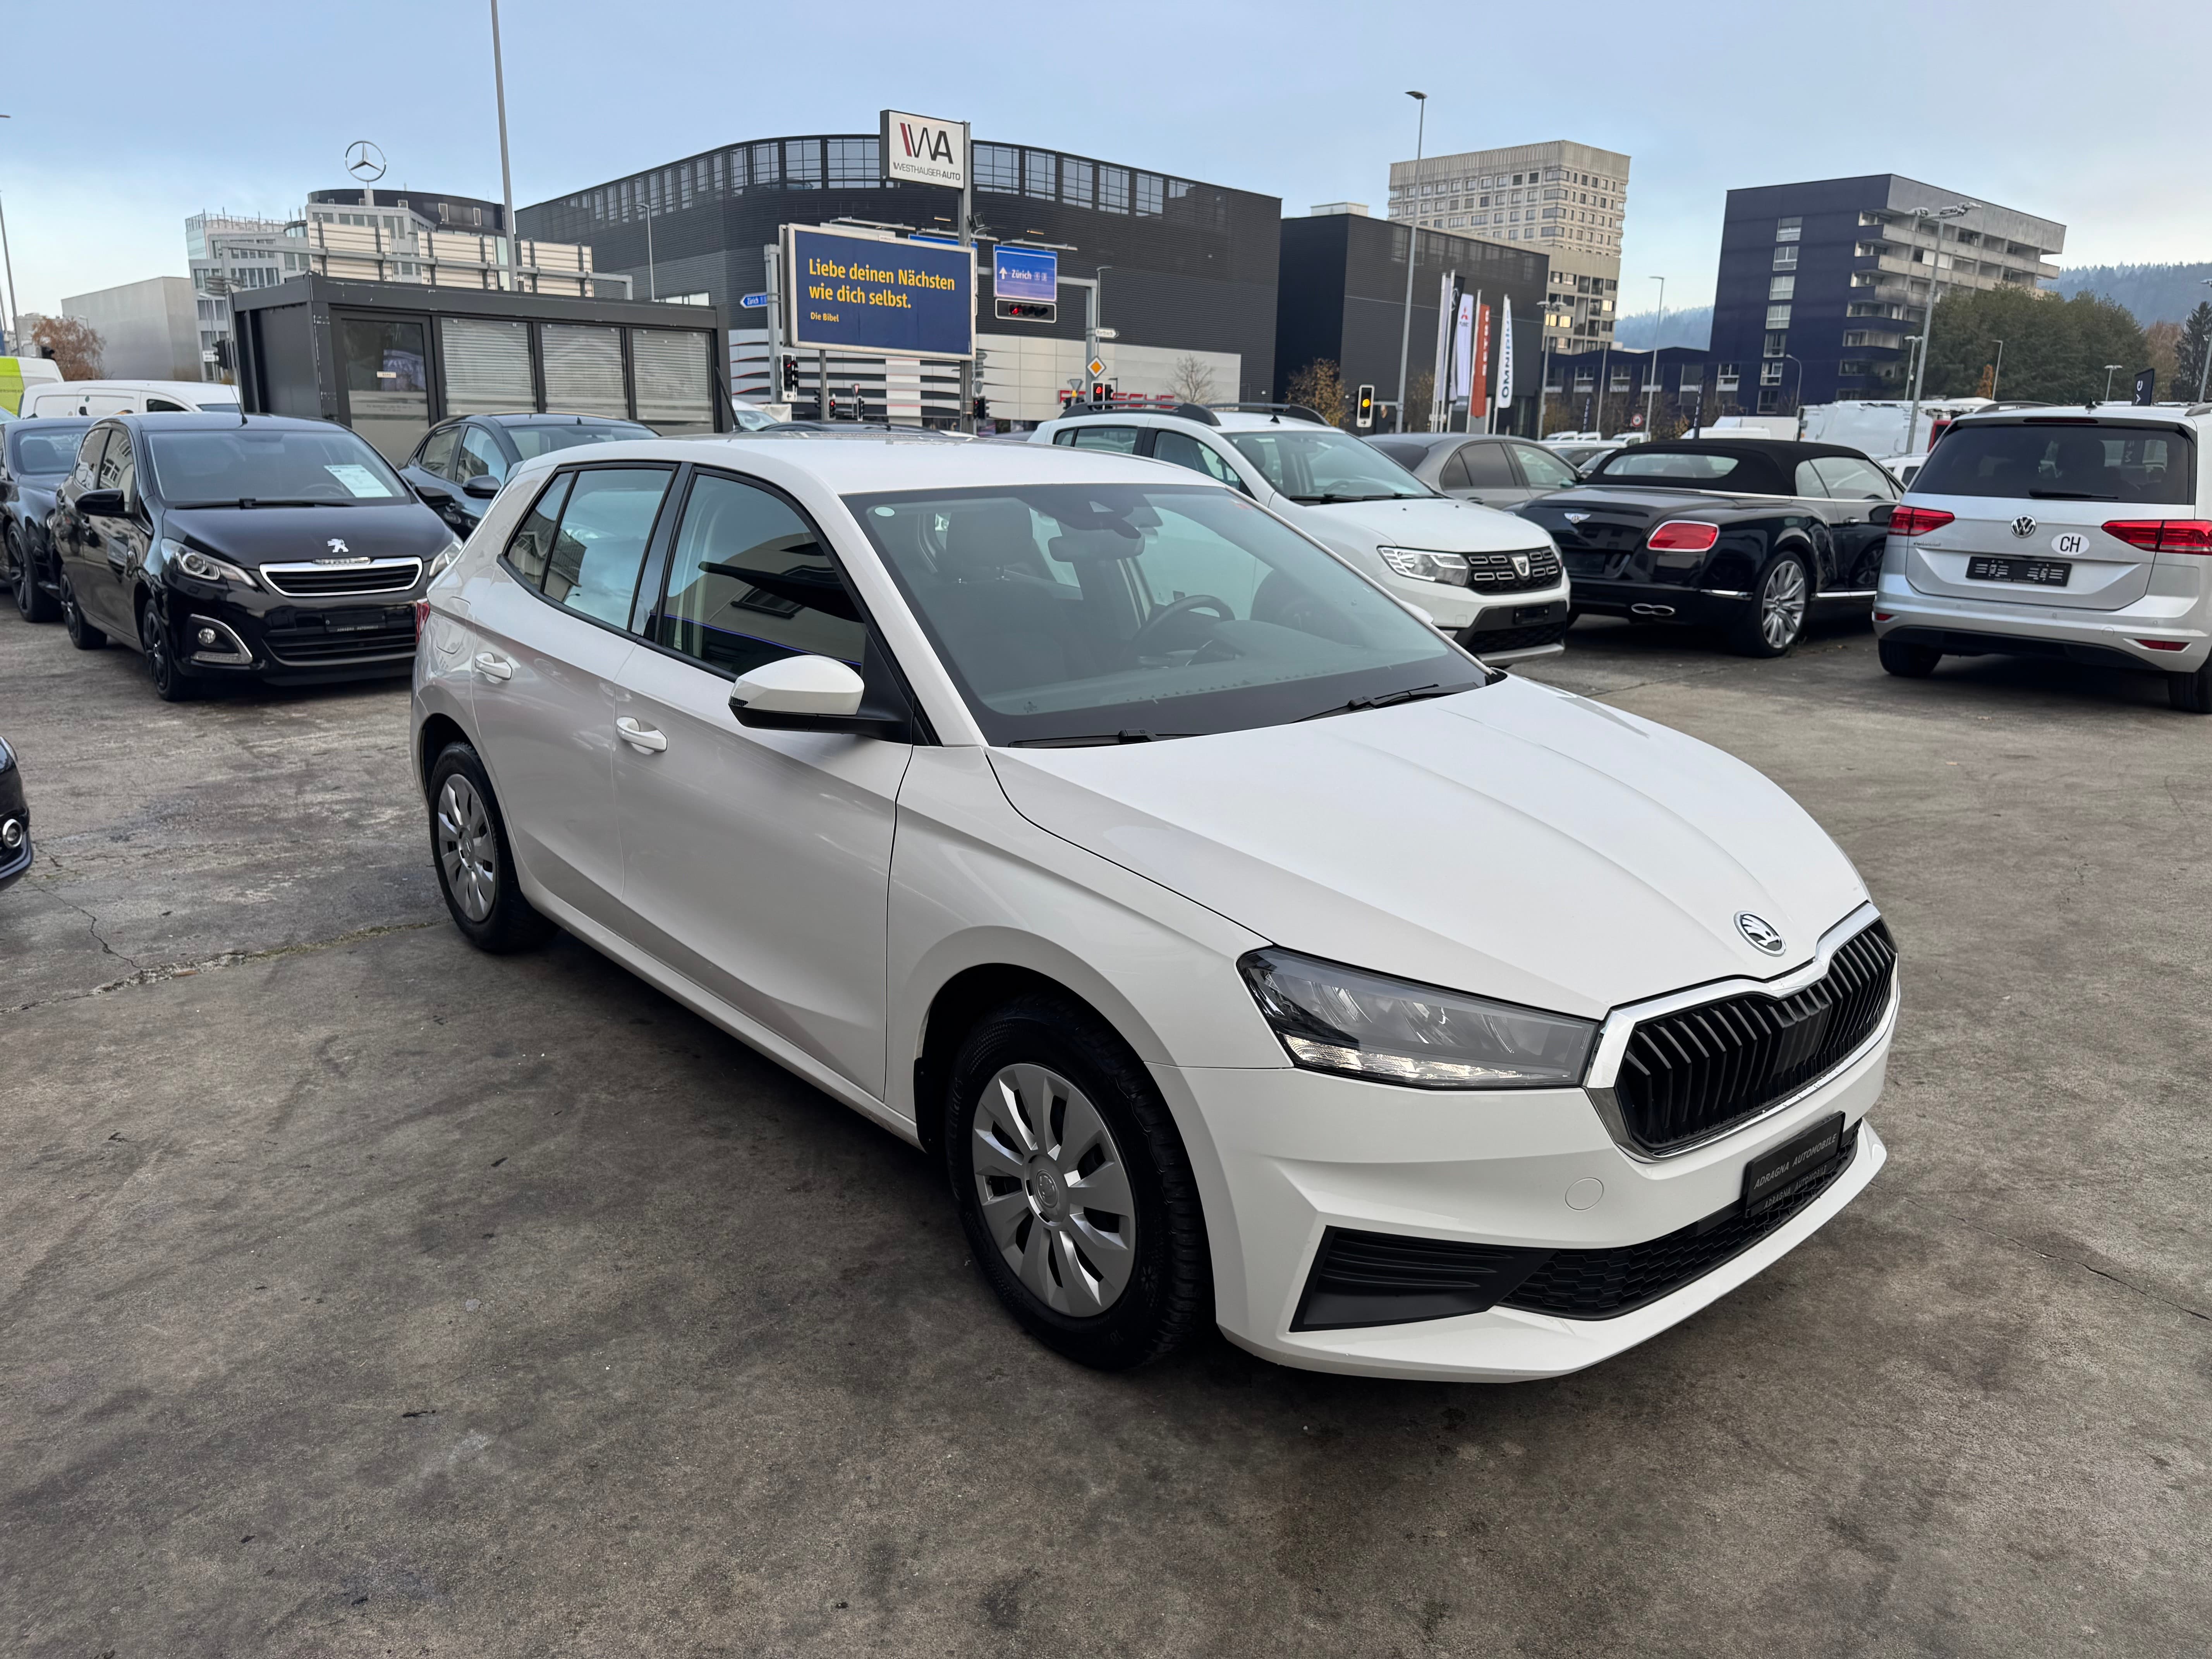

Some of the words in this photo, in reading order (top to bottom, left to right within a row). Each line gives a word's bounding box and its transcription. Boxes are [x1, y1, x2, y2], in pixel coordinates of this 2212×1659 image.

[809, 258, 846, 278] Liebe
[849, 263, 894, 284] deinen
[898, 269, 955, 290] Nächsten
[1012, 269, 1032, 280] Zürich
[809, 283, 833, 300] wie
[837, 285, 866, 304] dich
[869, 289, 911, 309] selbst.
[811, 312, 821, 321] Die
[823, 313, 839, 322] Bibel
[2059, 536, 2081, 553] CH
[1754, 1161, 1790, 1190] ADRAGNA
[1792, 1133, 1837, 1167] AUTOMOBILE
[1764, 1187, 1791, 1209] ADRAGNA
[1794, 1164, 1827, 1192] AUTOMOBILE
